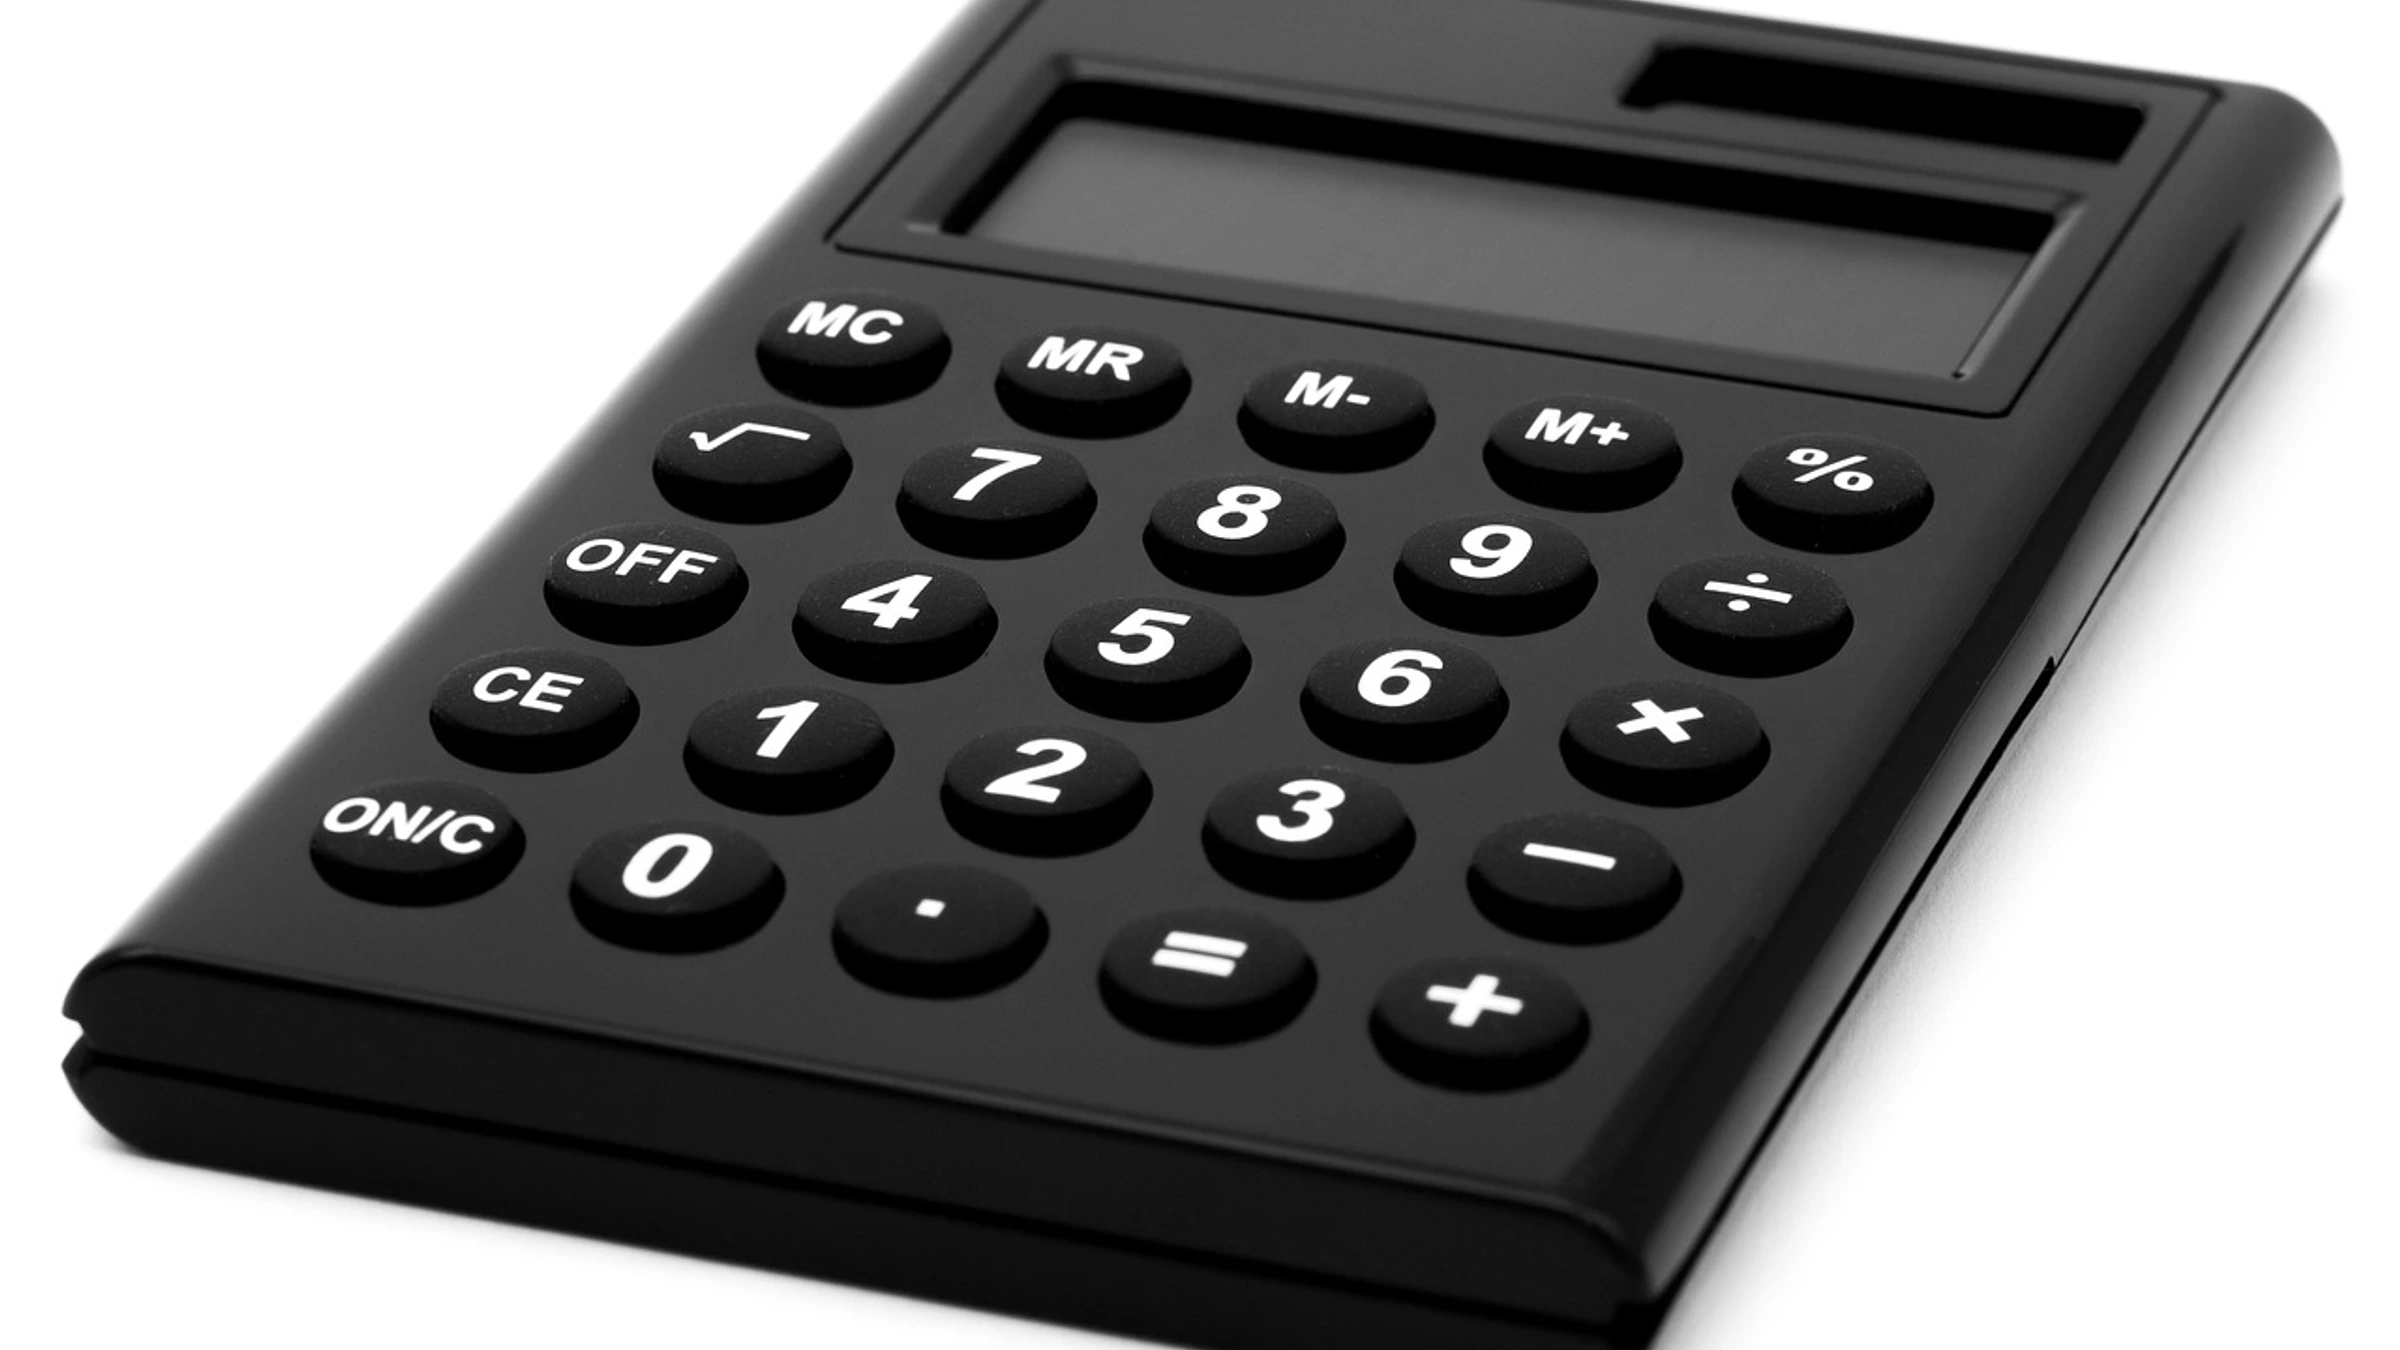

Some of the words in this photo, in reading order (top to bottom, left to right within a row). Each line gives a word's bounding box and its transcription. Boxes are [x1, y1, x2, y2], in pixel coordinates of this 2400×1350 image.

[787, 300, 904, 345] MC
[1027, 335, 1144, 381] MR
[1524, 407, 1630, 446] M+
[952, 447, 1042, 501] 7
[1786, 447, 1874, 492] %
[1196, 484, 1282, 540] 8
[566, 538, 719, 584] OFF
[1449, 524, 1533, 579] 9
[840, 574, 933, 630] 4
[1097, 607, 1192, 666] 5
[472, 666, 585, 713] CE
[1357, 649, 1444, 707] 6
[756, 699, 820, 759] 1
[984, 738, 1087, 804] 2
[322, 797, 495, 855] ON/C
[1256, 778, 1346, 843] 3
[622, 832, 714, 899] 0
[1152, 930, 1248, 977] =
[1426, 974, 1523, 1028] +
